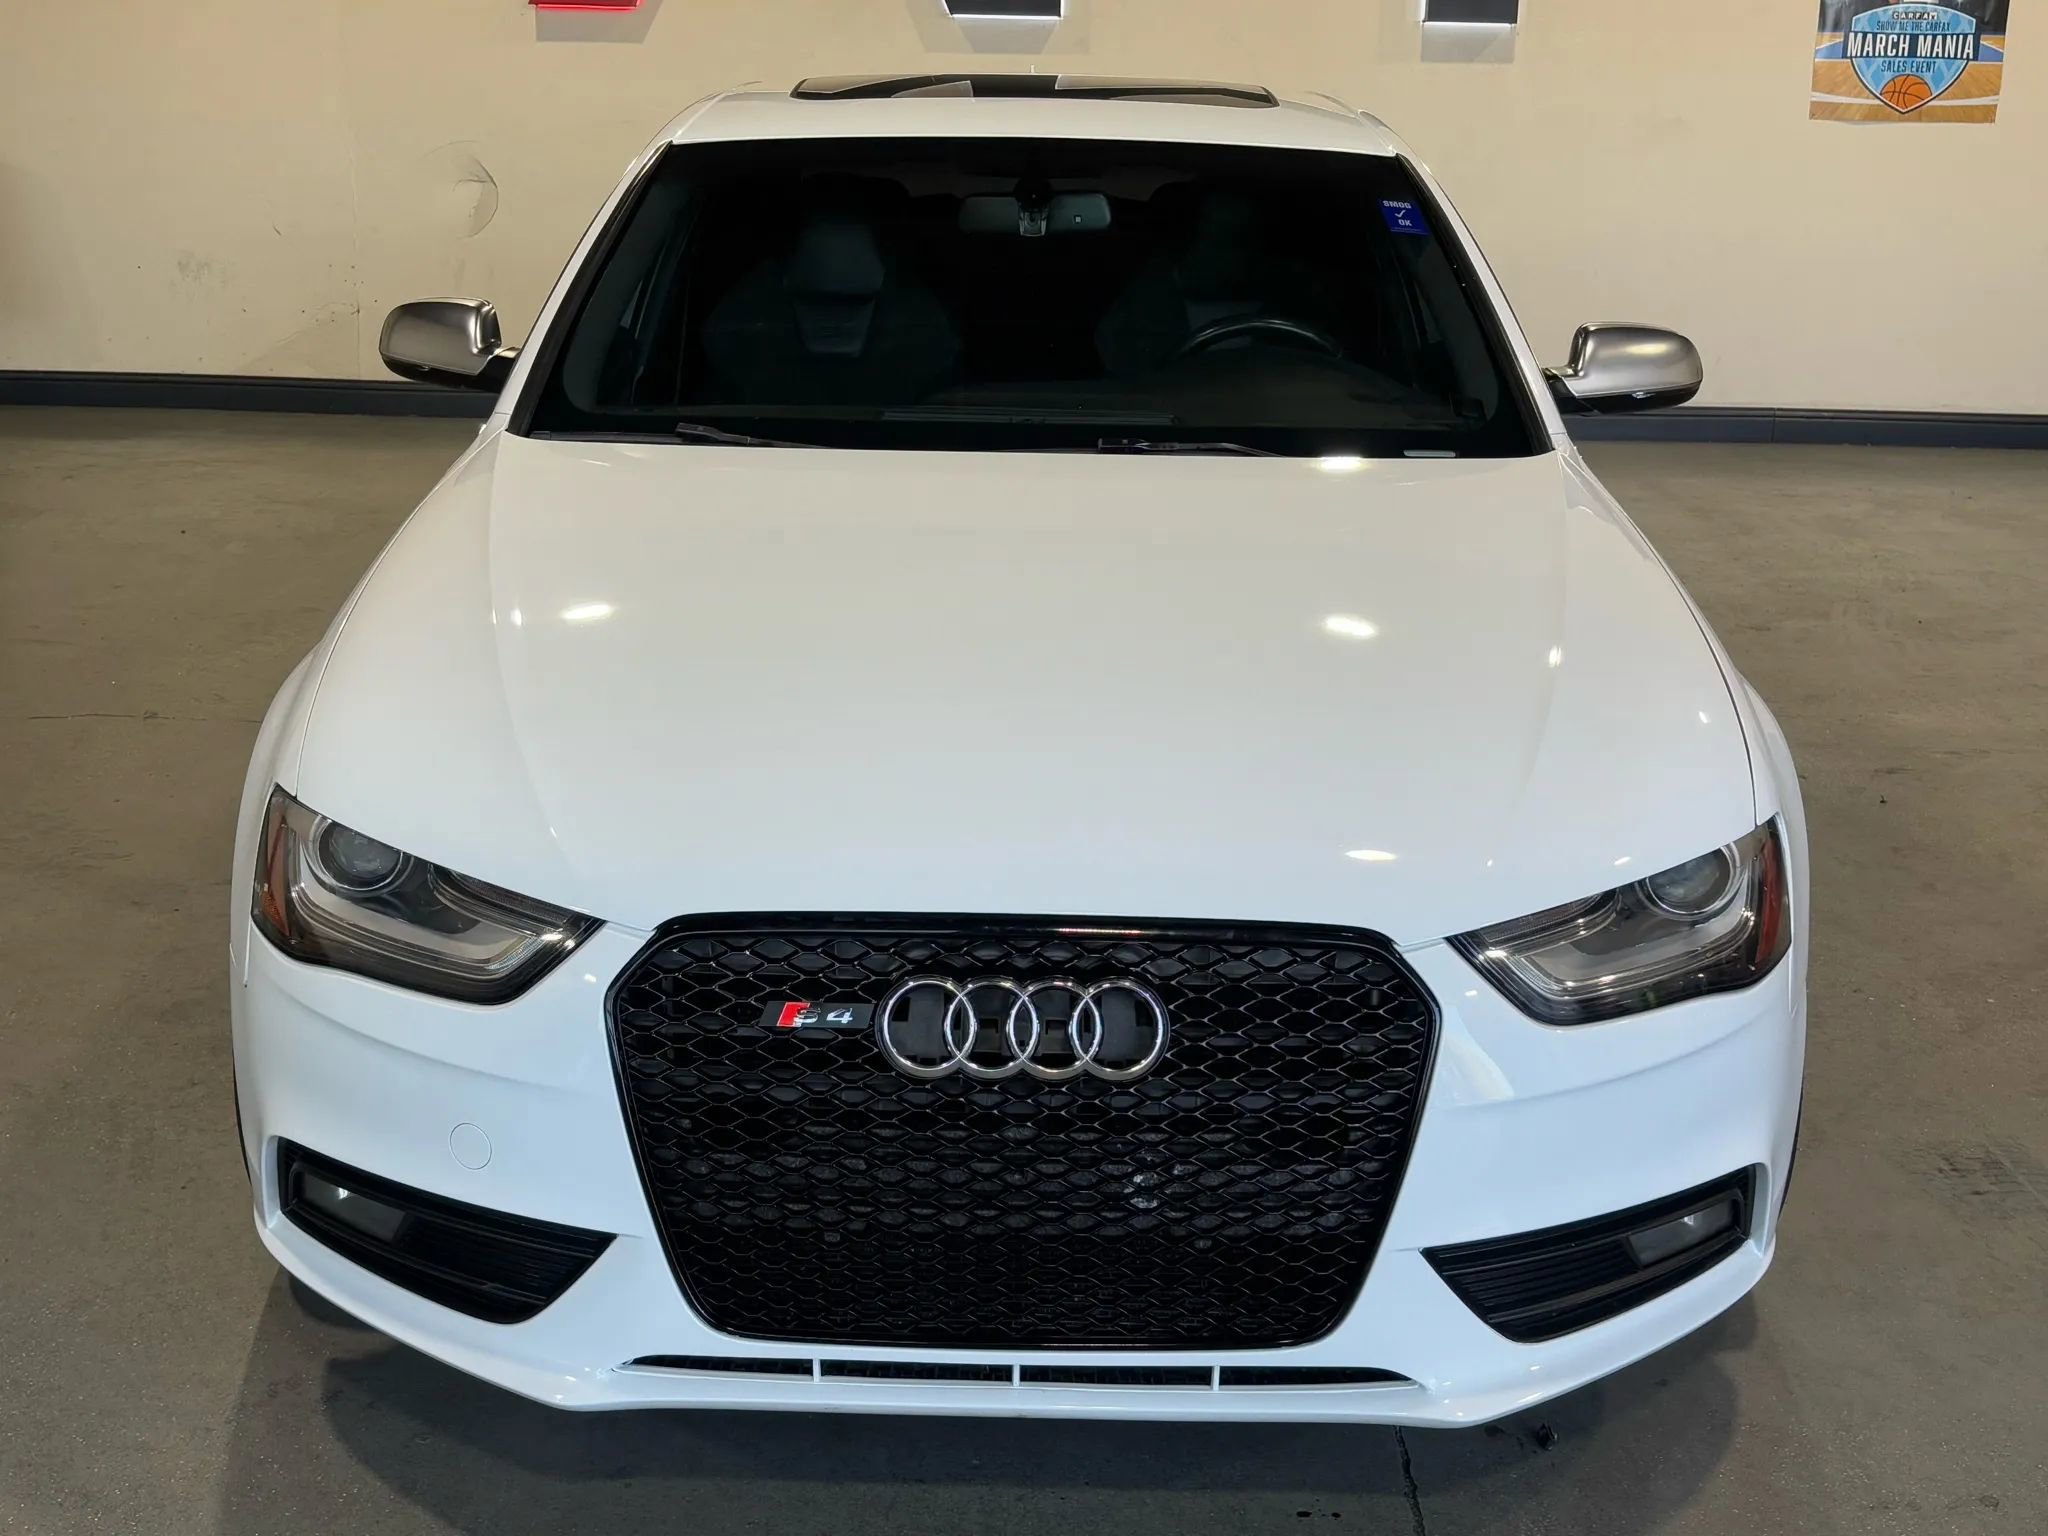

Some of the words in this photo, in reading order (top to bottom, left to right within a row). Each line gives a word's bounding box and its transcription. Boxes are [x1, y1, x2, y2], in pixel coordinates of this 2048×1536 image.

[1876, 20, 1897, 31] SHOW
[1900, 21, 1909, 31] ME
[1911, 21, 1923, 31] THE
[1924, 21, 1951, 32] CARFAX
[1847, 32, 1910, 57] MARCH
[1917, 33, 1974, 59] MANIA
[1881, 60, 1907, 73] SALES
[1910, 61, 1937, 73] EVENT
[1382, 200, 1412, 209] SMOG
